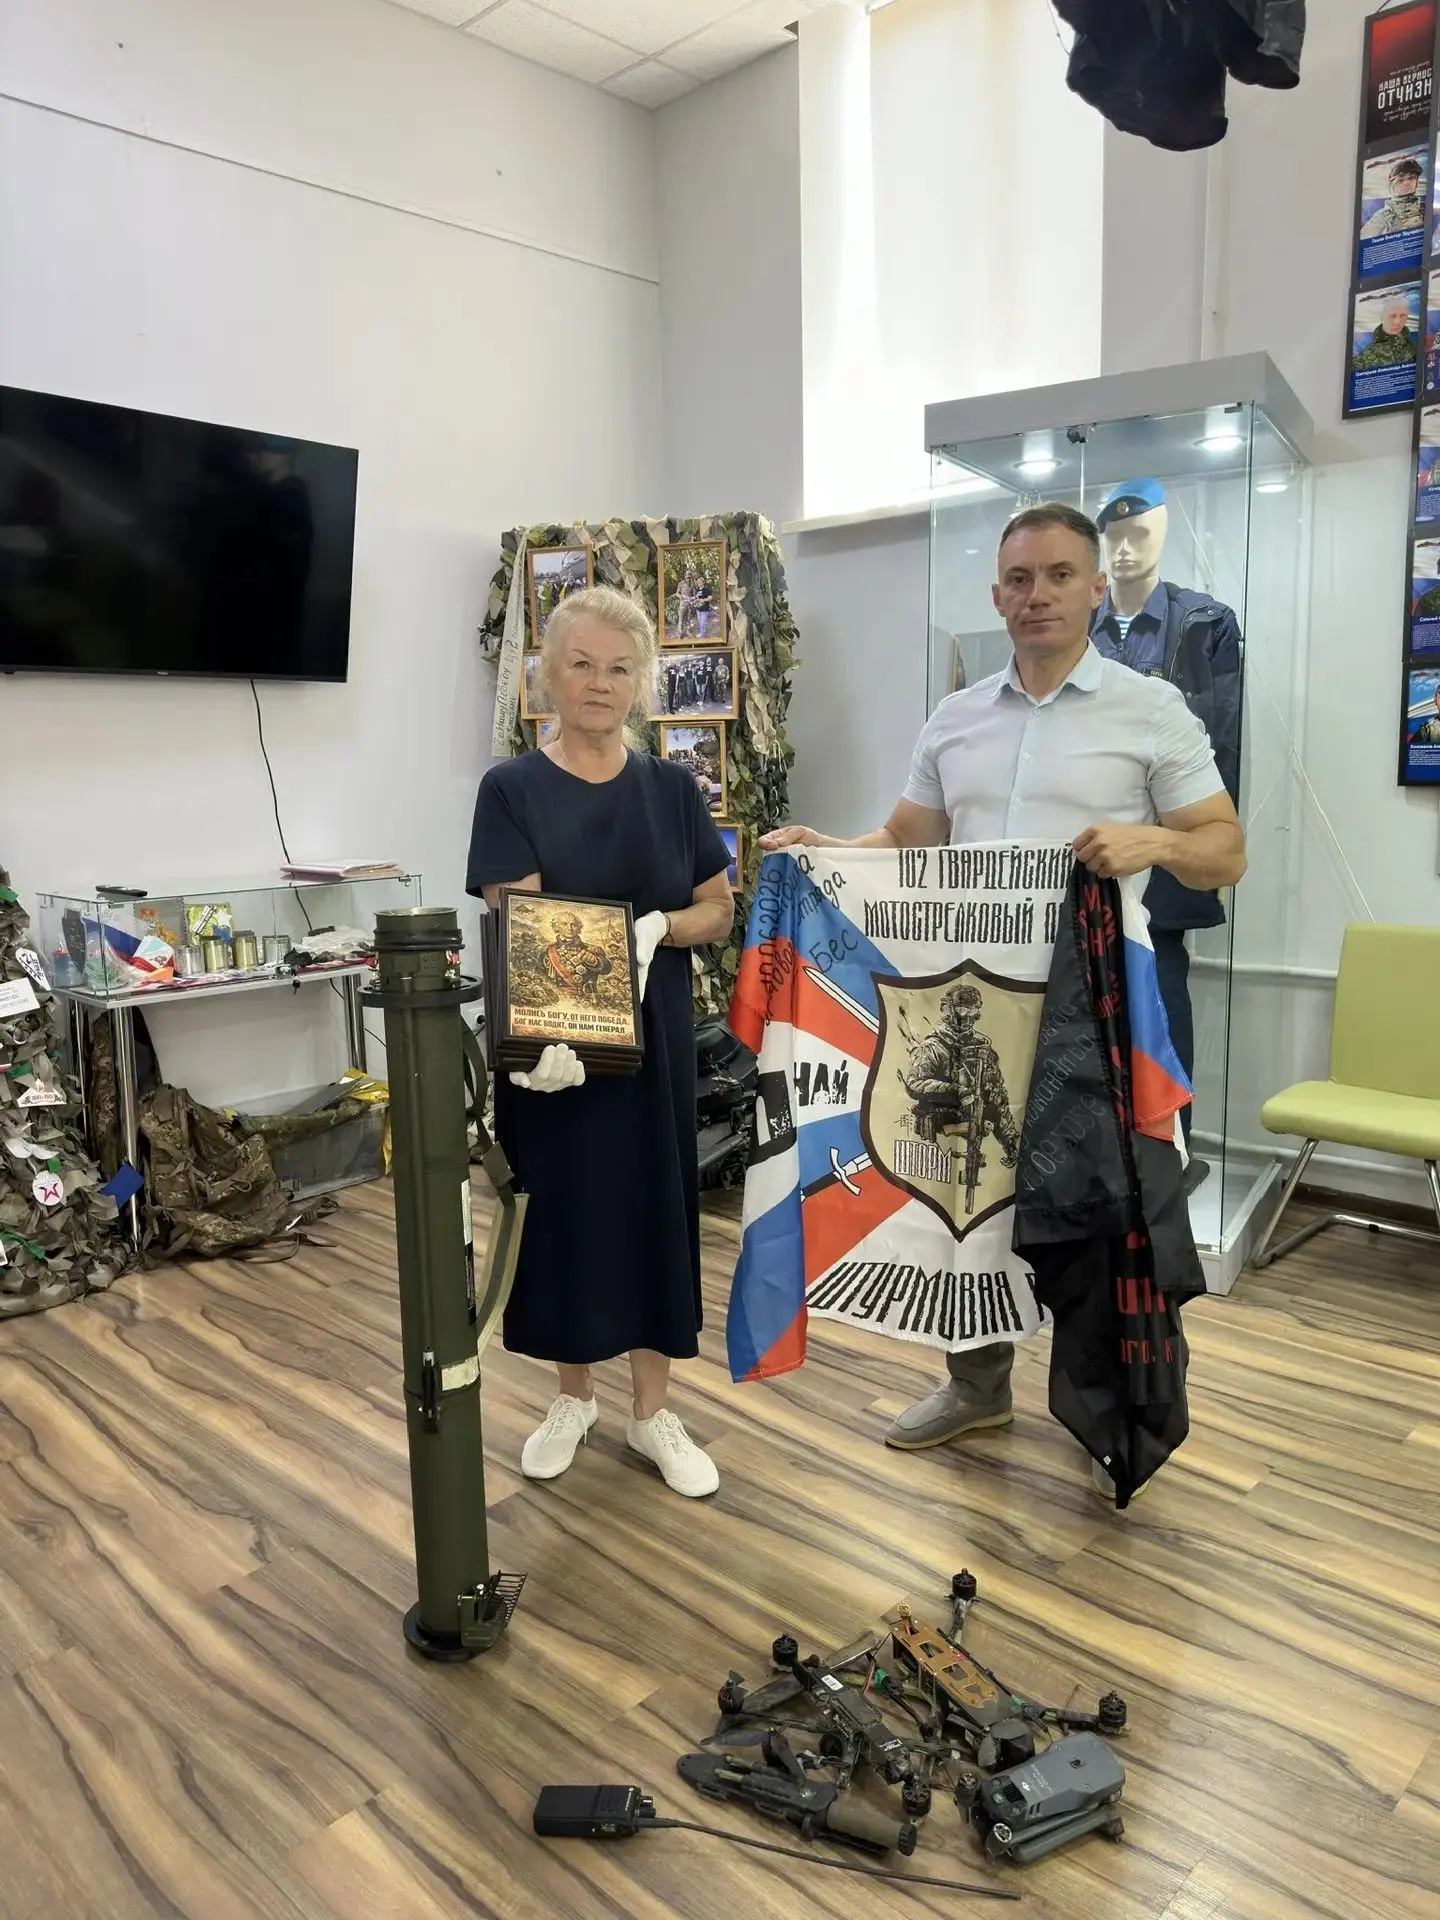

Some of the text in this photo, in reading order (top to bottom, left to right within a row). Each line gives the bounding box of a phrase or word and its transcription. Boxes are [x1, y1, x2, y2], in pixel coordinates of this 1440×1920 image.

[1377, 77, 1432, 109] ОТЧИЗН
[1402, 67, 1432, 85] ВЕРНОС
[897, 843, 1073, 890] 102 ГВАРДЕЙСКИЙ
[863, 898, 1035, 945] МОТОСТРЕЛКОВЫЙ
[1044, 902, 1065, 944] П
[809, 929, 858, 974] Бес
[514, 1008, 546, 1018] МОЛИСЬ
[580, 1014, 597, 1022] НЕГО
[528, 1019, 542, 1027] НАС
[568, 1022, 578, 1030] ОН
[578, 1023, 594, 1031] НАМ
[595, 1024, 625, 1034] ГЕНЕРАЛ
[894, 1139, 952, 1185] ШТОРМ
[806, 1261, 1024, 1341] ШТУРМОВАЯ
